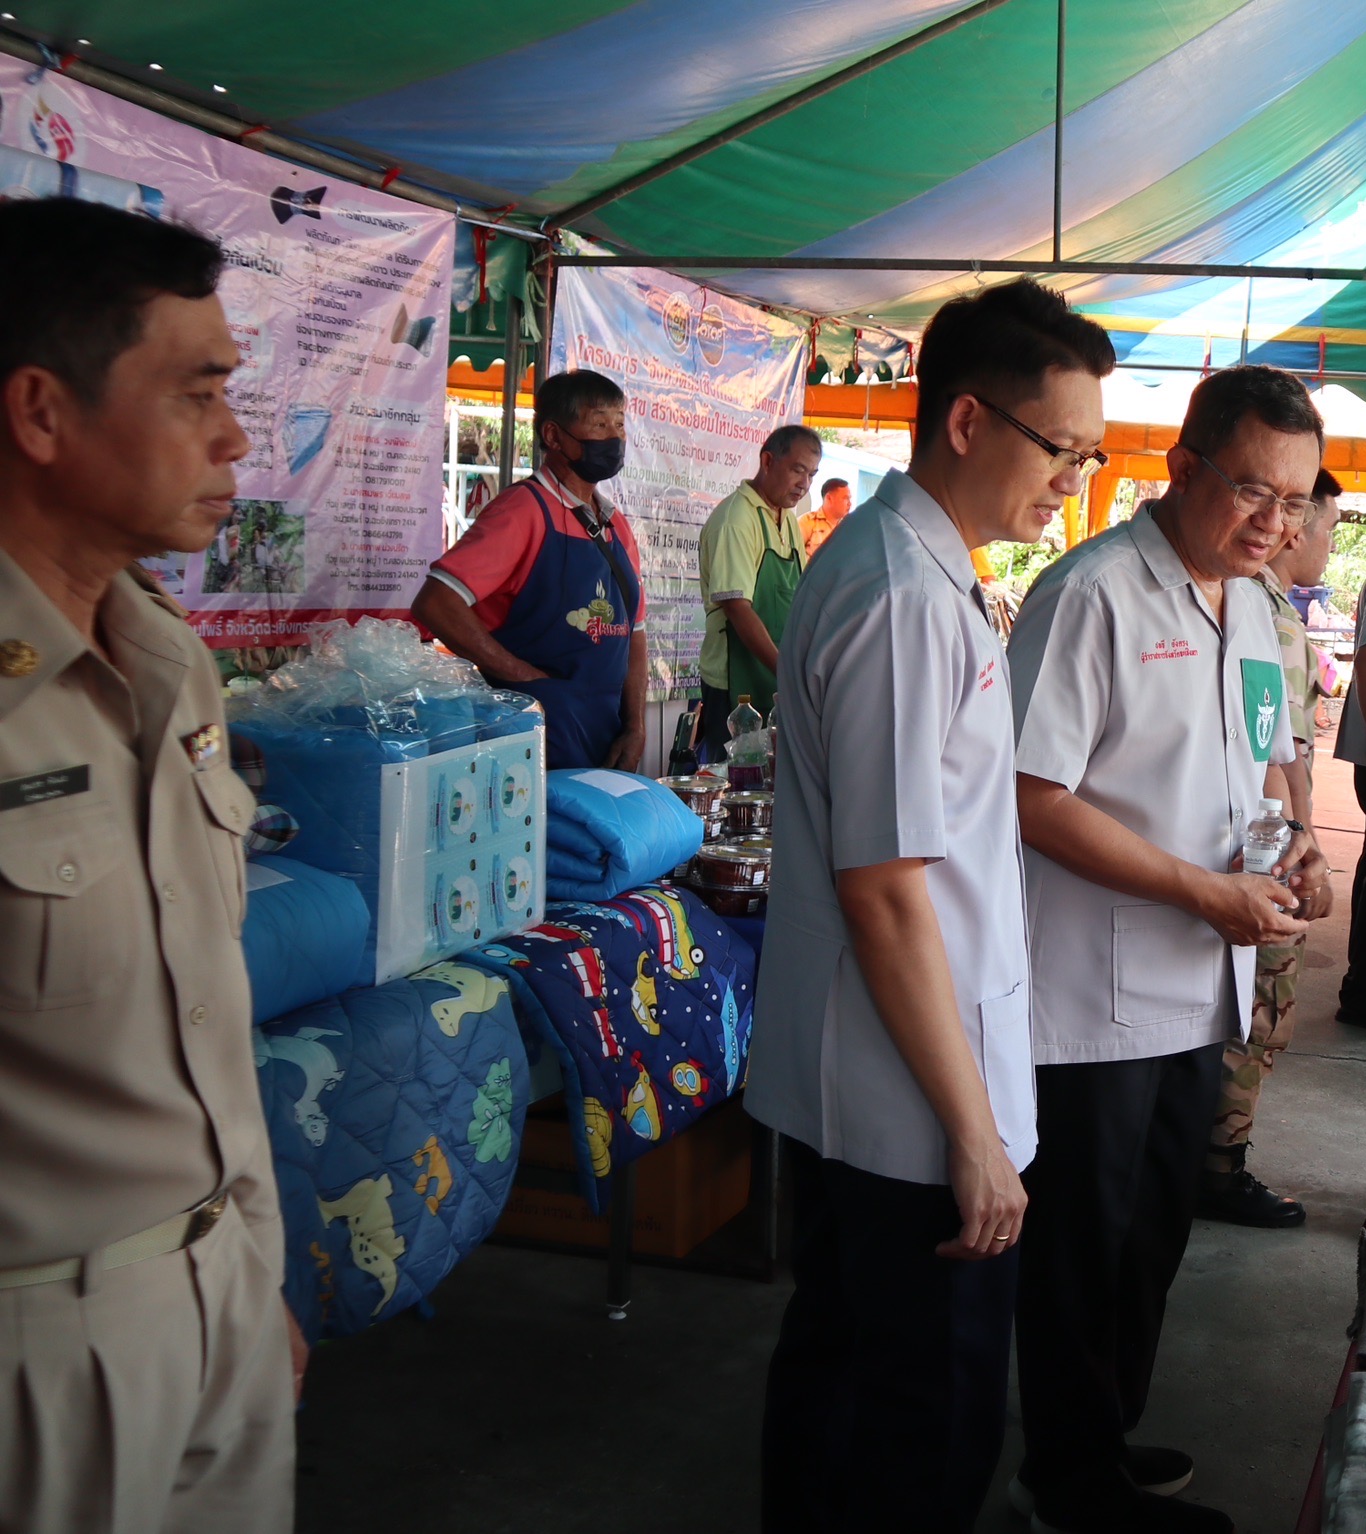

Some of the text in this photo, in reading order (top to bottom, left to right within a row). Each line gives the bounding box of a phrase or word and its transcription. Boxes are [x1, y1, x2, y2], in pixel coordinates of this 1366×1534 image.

[576, 335, 639, 375] โครงการ
[633, 430, 706, 461] ประจำปีงบประมาณ
[724, 452, 742, 468] 2567
[663, 534, 674, 547] 15
